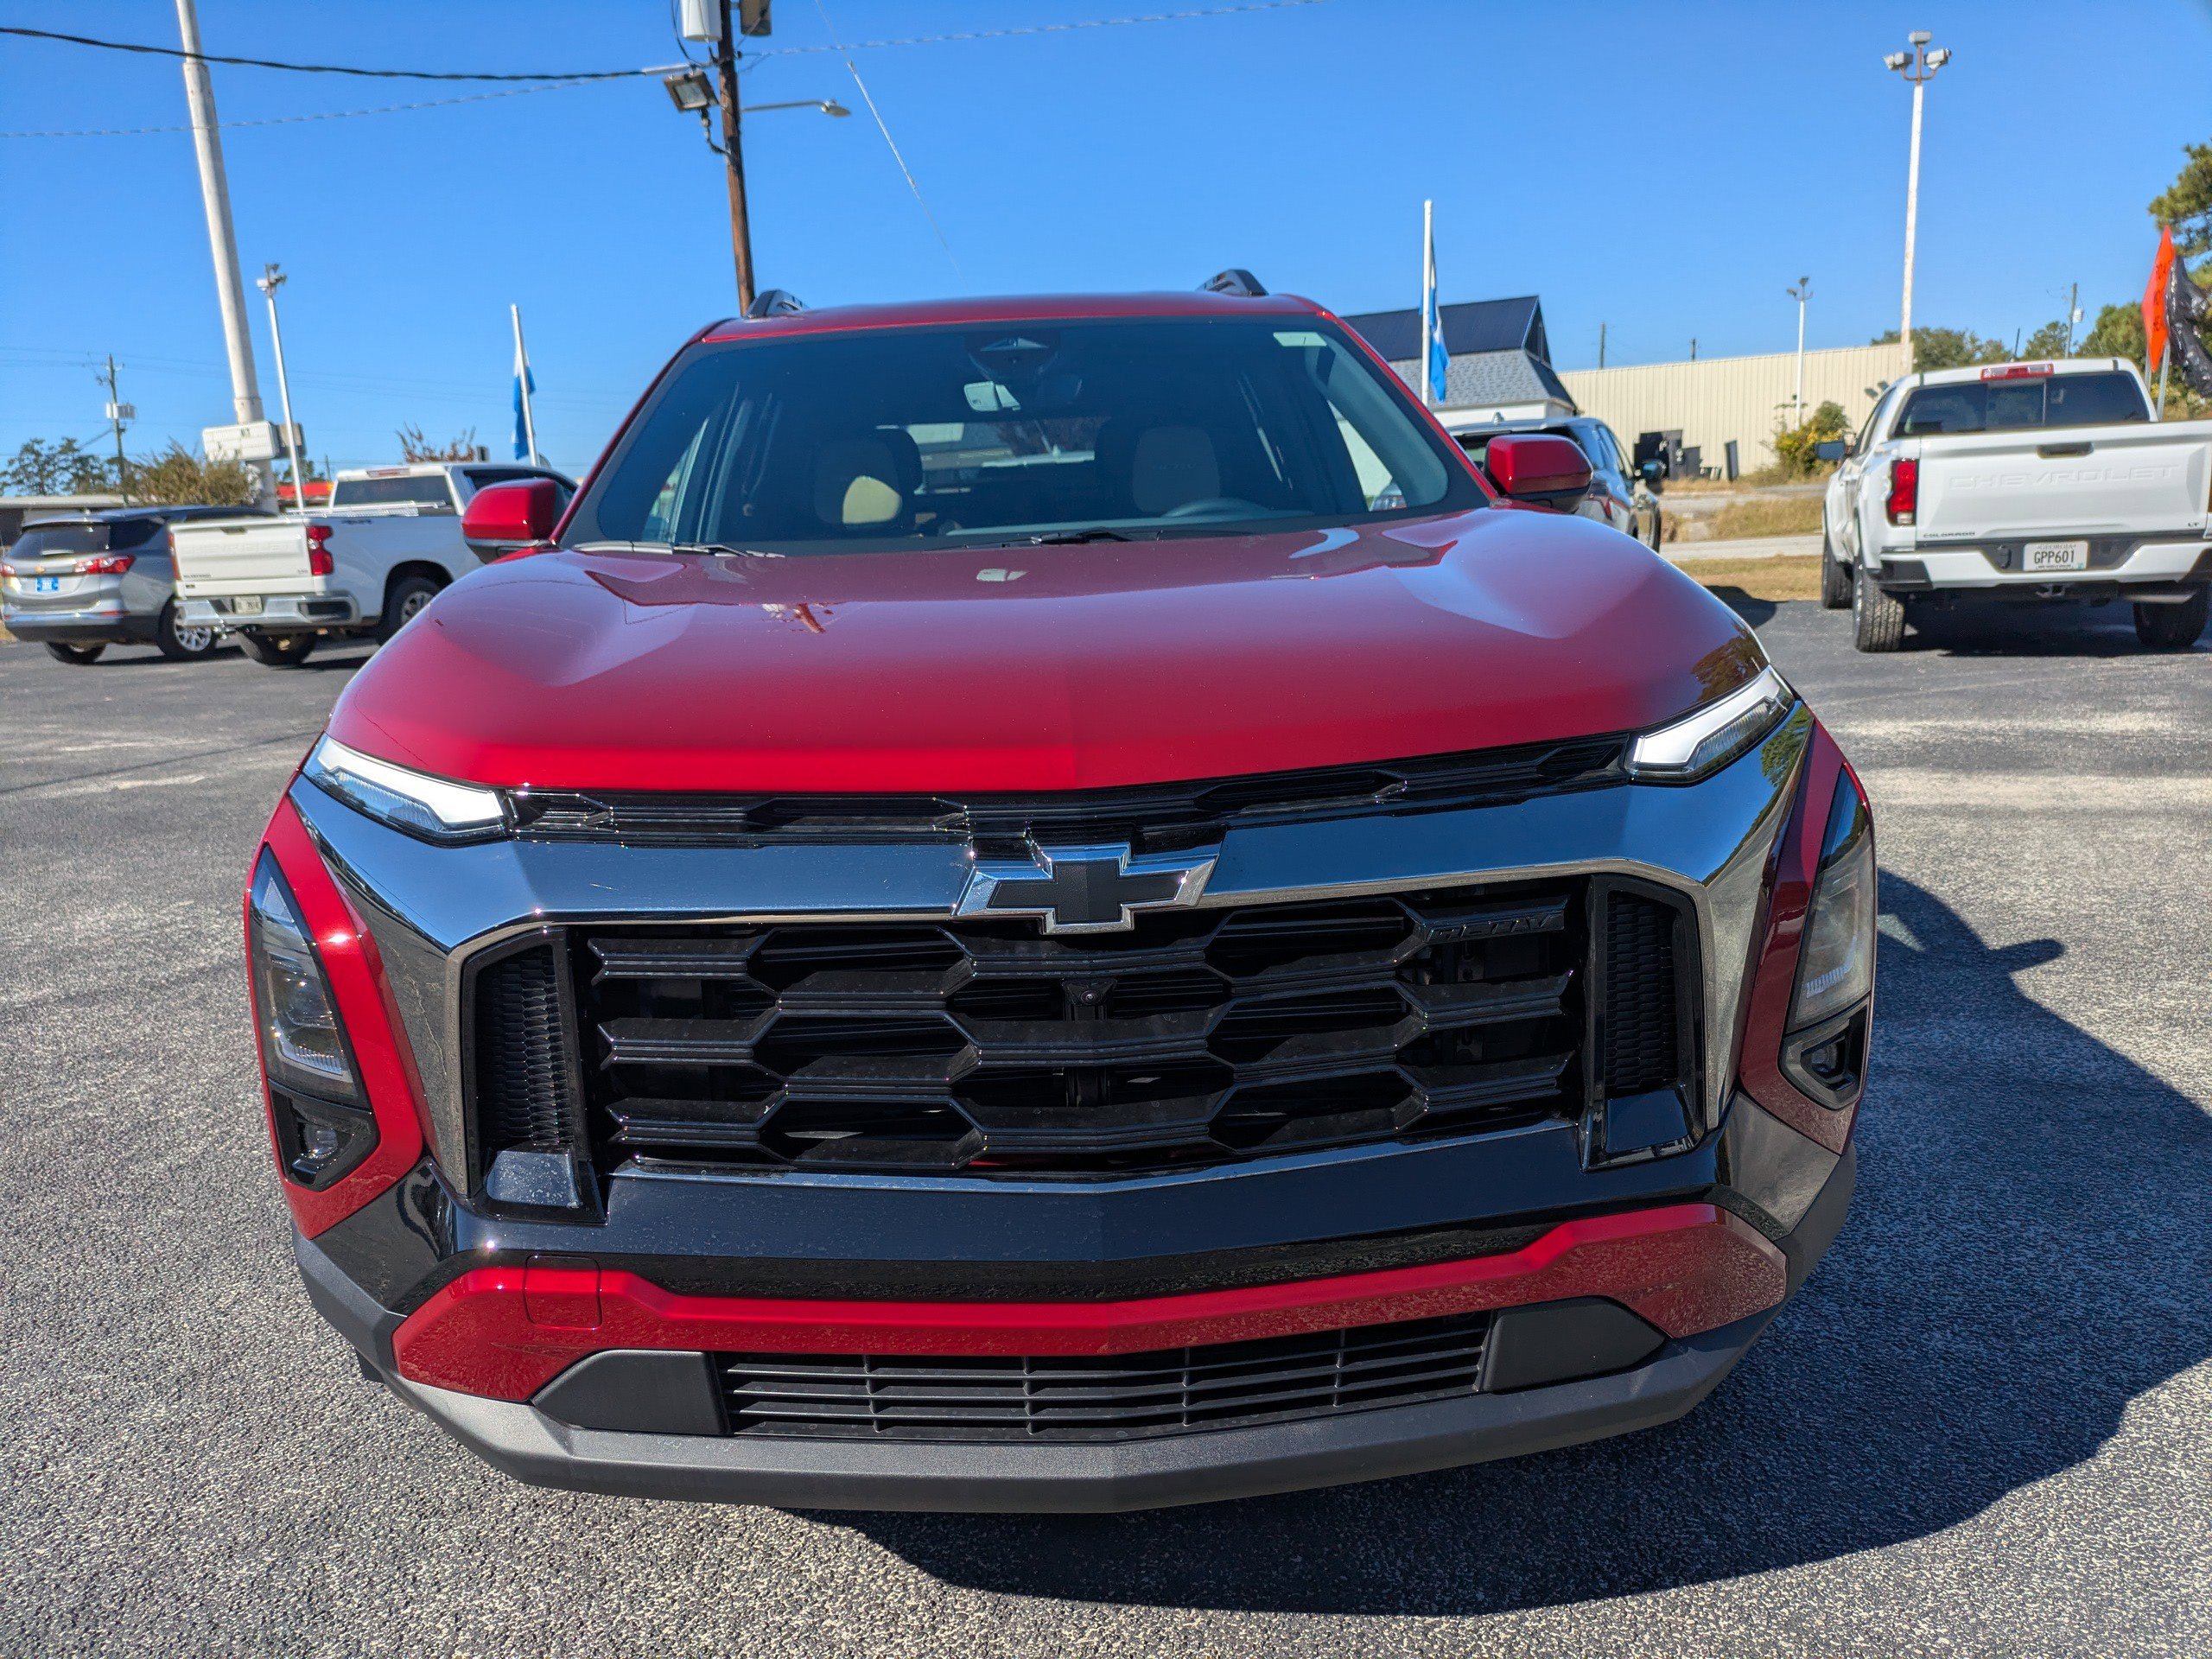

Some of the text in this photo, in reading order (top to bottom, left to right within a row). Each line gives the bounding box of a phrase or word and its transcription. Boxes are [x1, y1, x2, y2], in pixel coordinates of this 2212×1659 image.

[1948, 464, 2180, 491] CHEVROLET
[180, 541, 295, 556] CHEVROLET
[2034, 550, 2075, 564] GPP601
